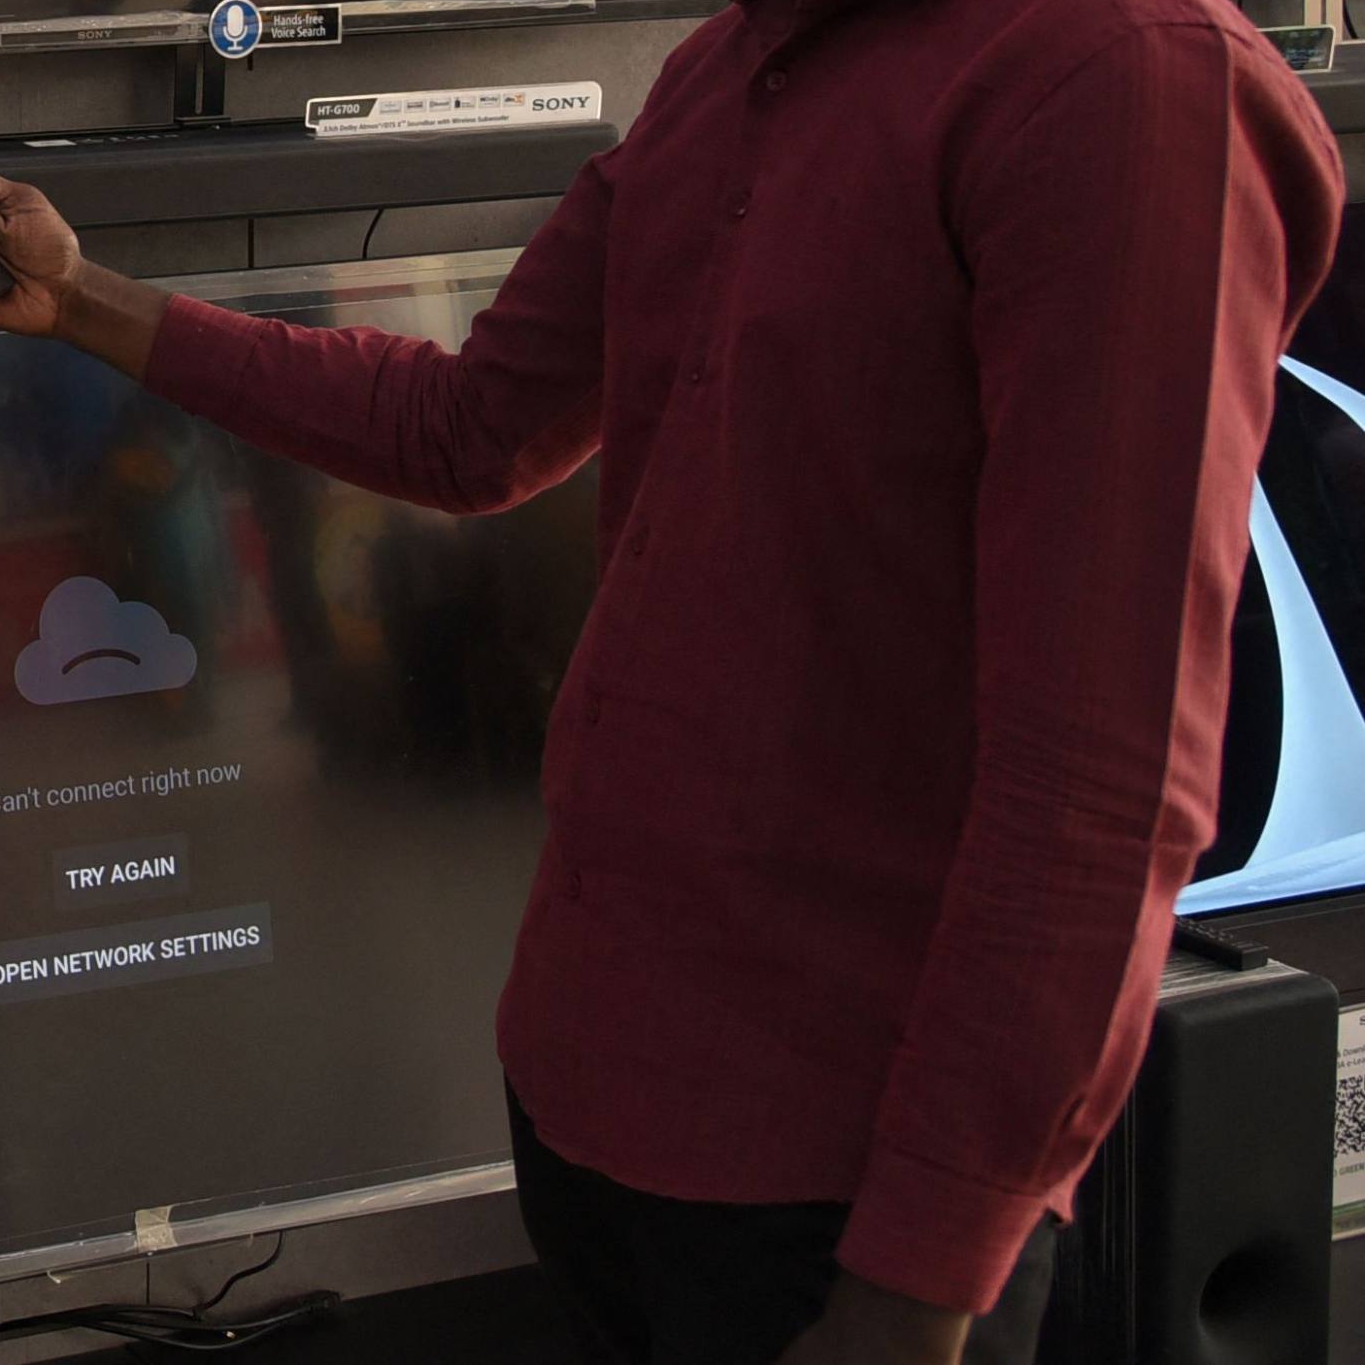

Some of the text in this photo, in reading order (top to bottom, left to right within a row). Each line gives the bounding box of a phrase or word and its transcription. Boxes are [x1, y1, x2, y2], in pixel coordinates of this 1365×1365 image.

[273, 14, 324, 25] Hands-free
[78, 30, 112, 40] SONY
[271, 26, 326, 39] Voice Search
[317, 104, 360, 115] HT-G700
[532, 96, 590, 111] SONY
[46, 775, 136, 807] connect
[141, 767, 190, 796] right
[197, 763, 242, 785] now
[66, 856, 176, 890] TRY AGAIN
[53, 942, 155, 977] NETWORK
[160, 926, 260, 960] SETTINGS
